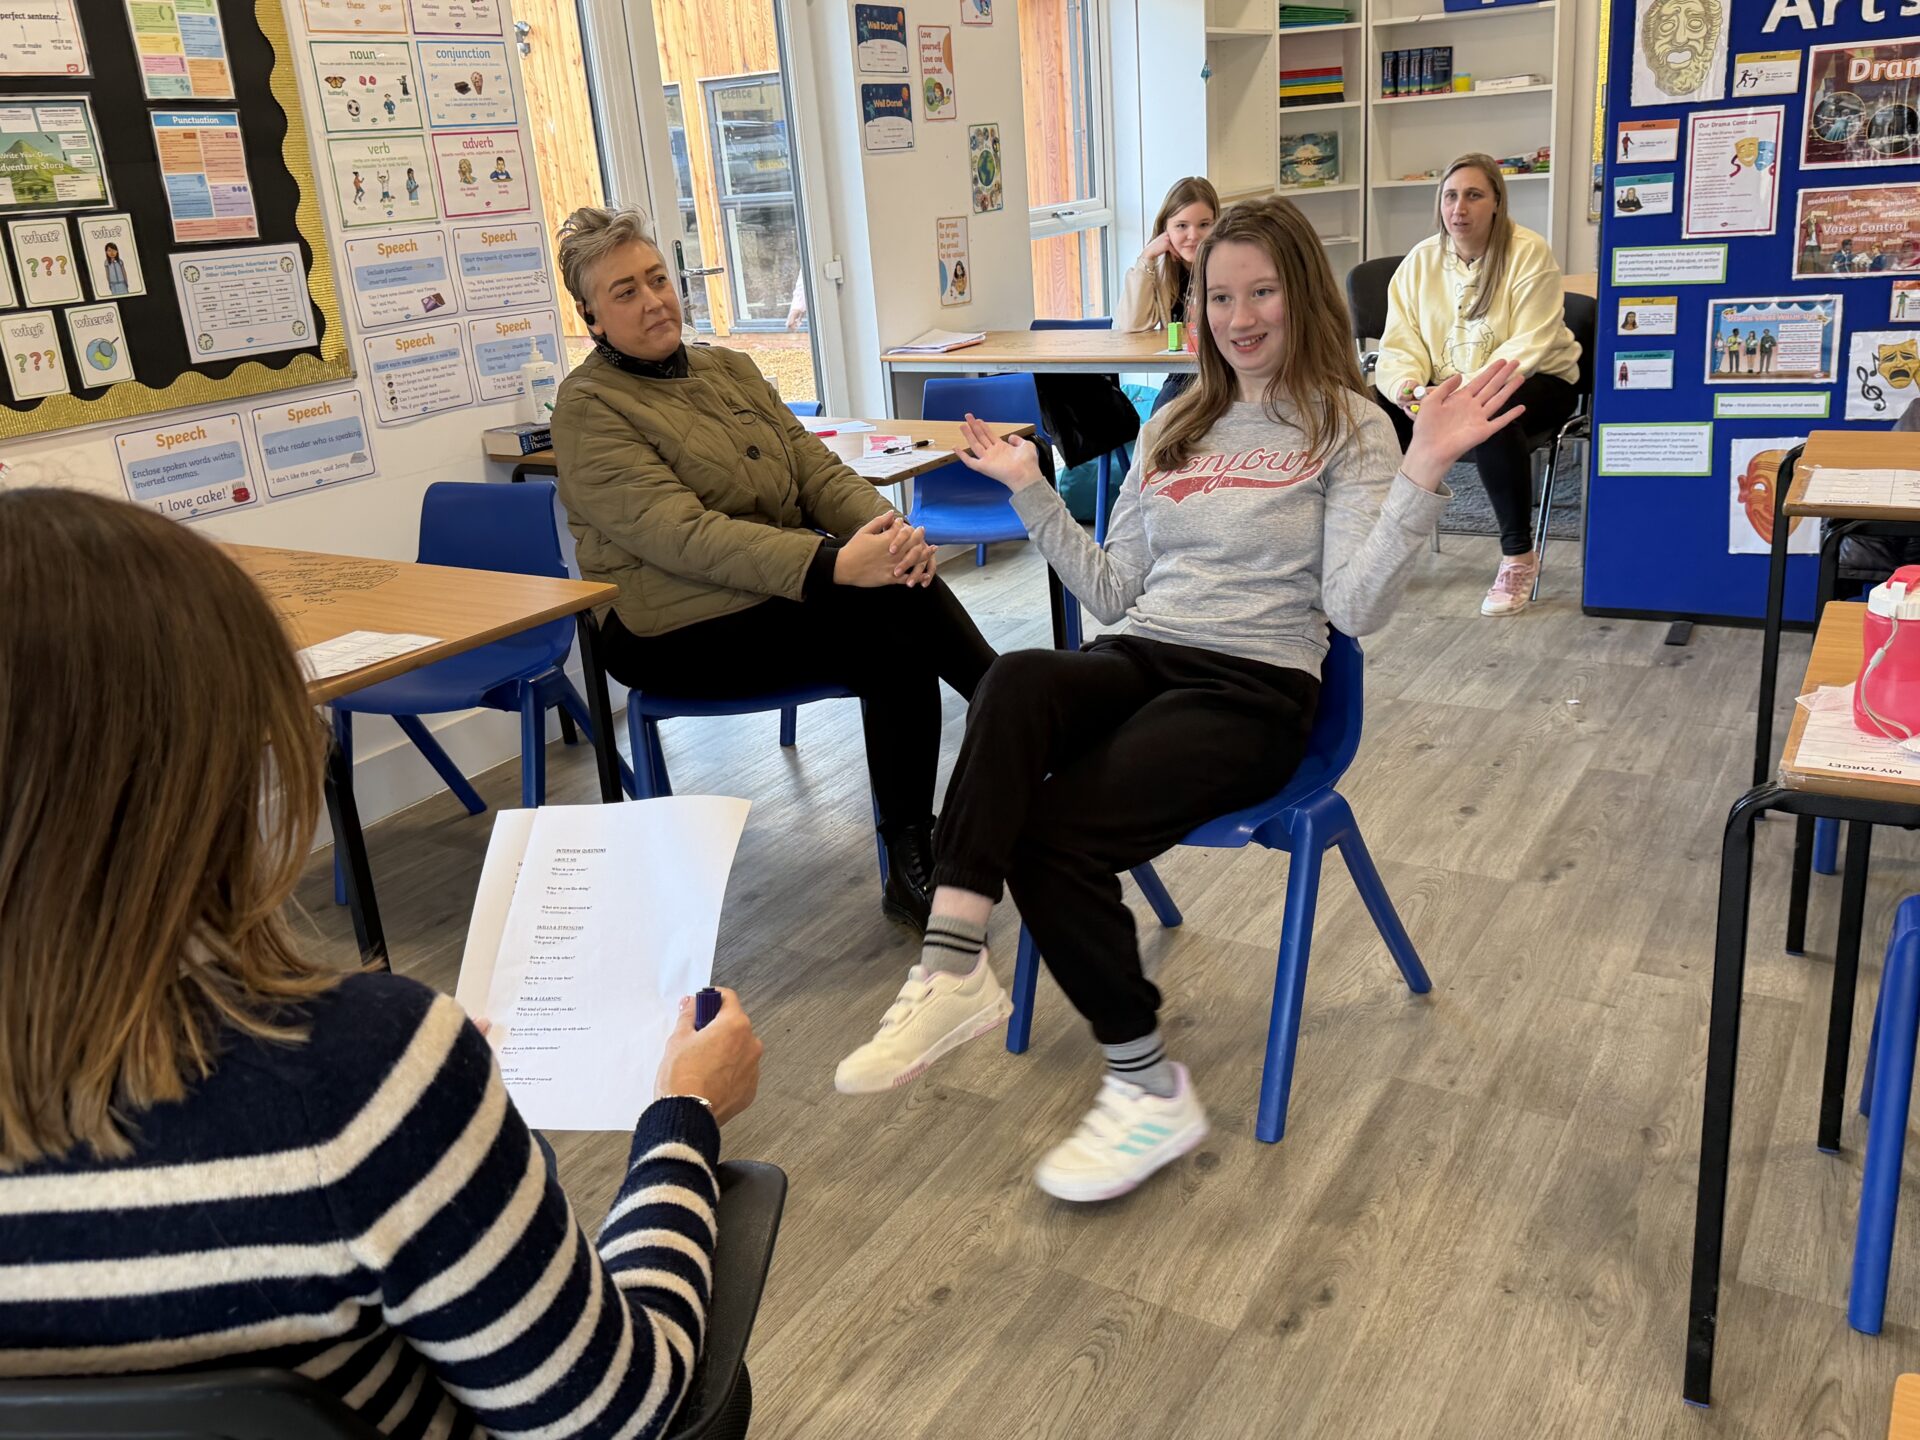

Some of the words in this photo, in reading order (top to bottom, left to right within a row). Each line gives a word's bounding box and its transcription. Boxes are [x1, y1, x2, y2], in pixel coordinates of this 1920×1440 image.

[379, 4, 391, 12] you
[0, 12, 26, 20] perfect
[921, 30, 932, 39] Love
[350, 50, 377, 59] noun
[436, 47, 490, 62] conjunction
[922, 55, 933, 63] Love
[1849, 58, 1920, 82] Dra
[719, 90, 752, 100] cience
[172, 115, 219, 125] Punctuation
[367, 142, 390, 154] verb
[462, 136, 494, 150] adverb
[0, 161, 40, 171] dventure
[40, 161, 64, 171] Story
[1807, 195, 1849, 205] modulation
[1833, 211, 1870, 220] projection
[92, 226, 121, 239] who?
[945, 222, 958, 232] proud
[1823, 223, 1857, 235] Voice
[1860, 221, 1910, 234] Control
[21, 230, 59, 244] what?
[481, 229, 518, 247] Speech
[377, 239, 418, 258] Speech
[946, 241, 959, 251] proud
[74, 312, 114, 328] where?
[11, 322, 44, 338] why?
[495, 318, 531, 336] Speech
[396, 333, 435, 352] Speech
[412, 356, 428, 364] speaker
[288, 401, 332, 423] Speech
[155, 426, 207, 449] Speech
[529, 434, 552, 442] Diction
[264, 447, 277, 456] Tell
[278, 445, 289, 453] the
[290, 441, 311, 451] reader
[312, 437, 327, 446] who
[529, 440, 553, 450] Thesau
[132, 467, 161, 479] Enclose
[162, 461, 187, 473] spoken
[188, 456, 211, 466] words
[212, 451, 236, 462] within
[135, 477, 166, 489] inverted
[168, 498, 193, 512] love
[1827, 762, 1877, 772] TARGET
